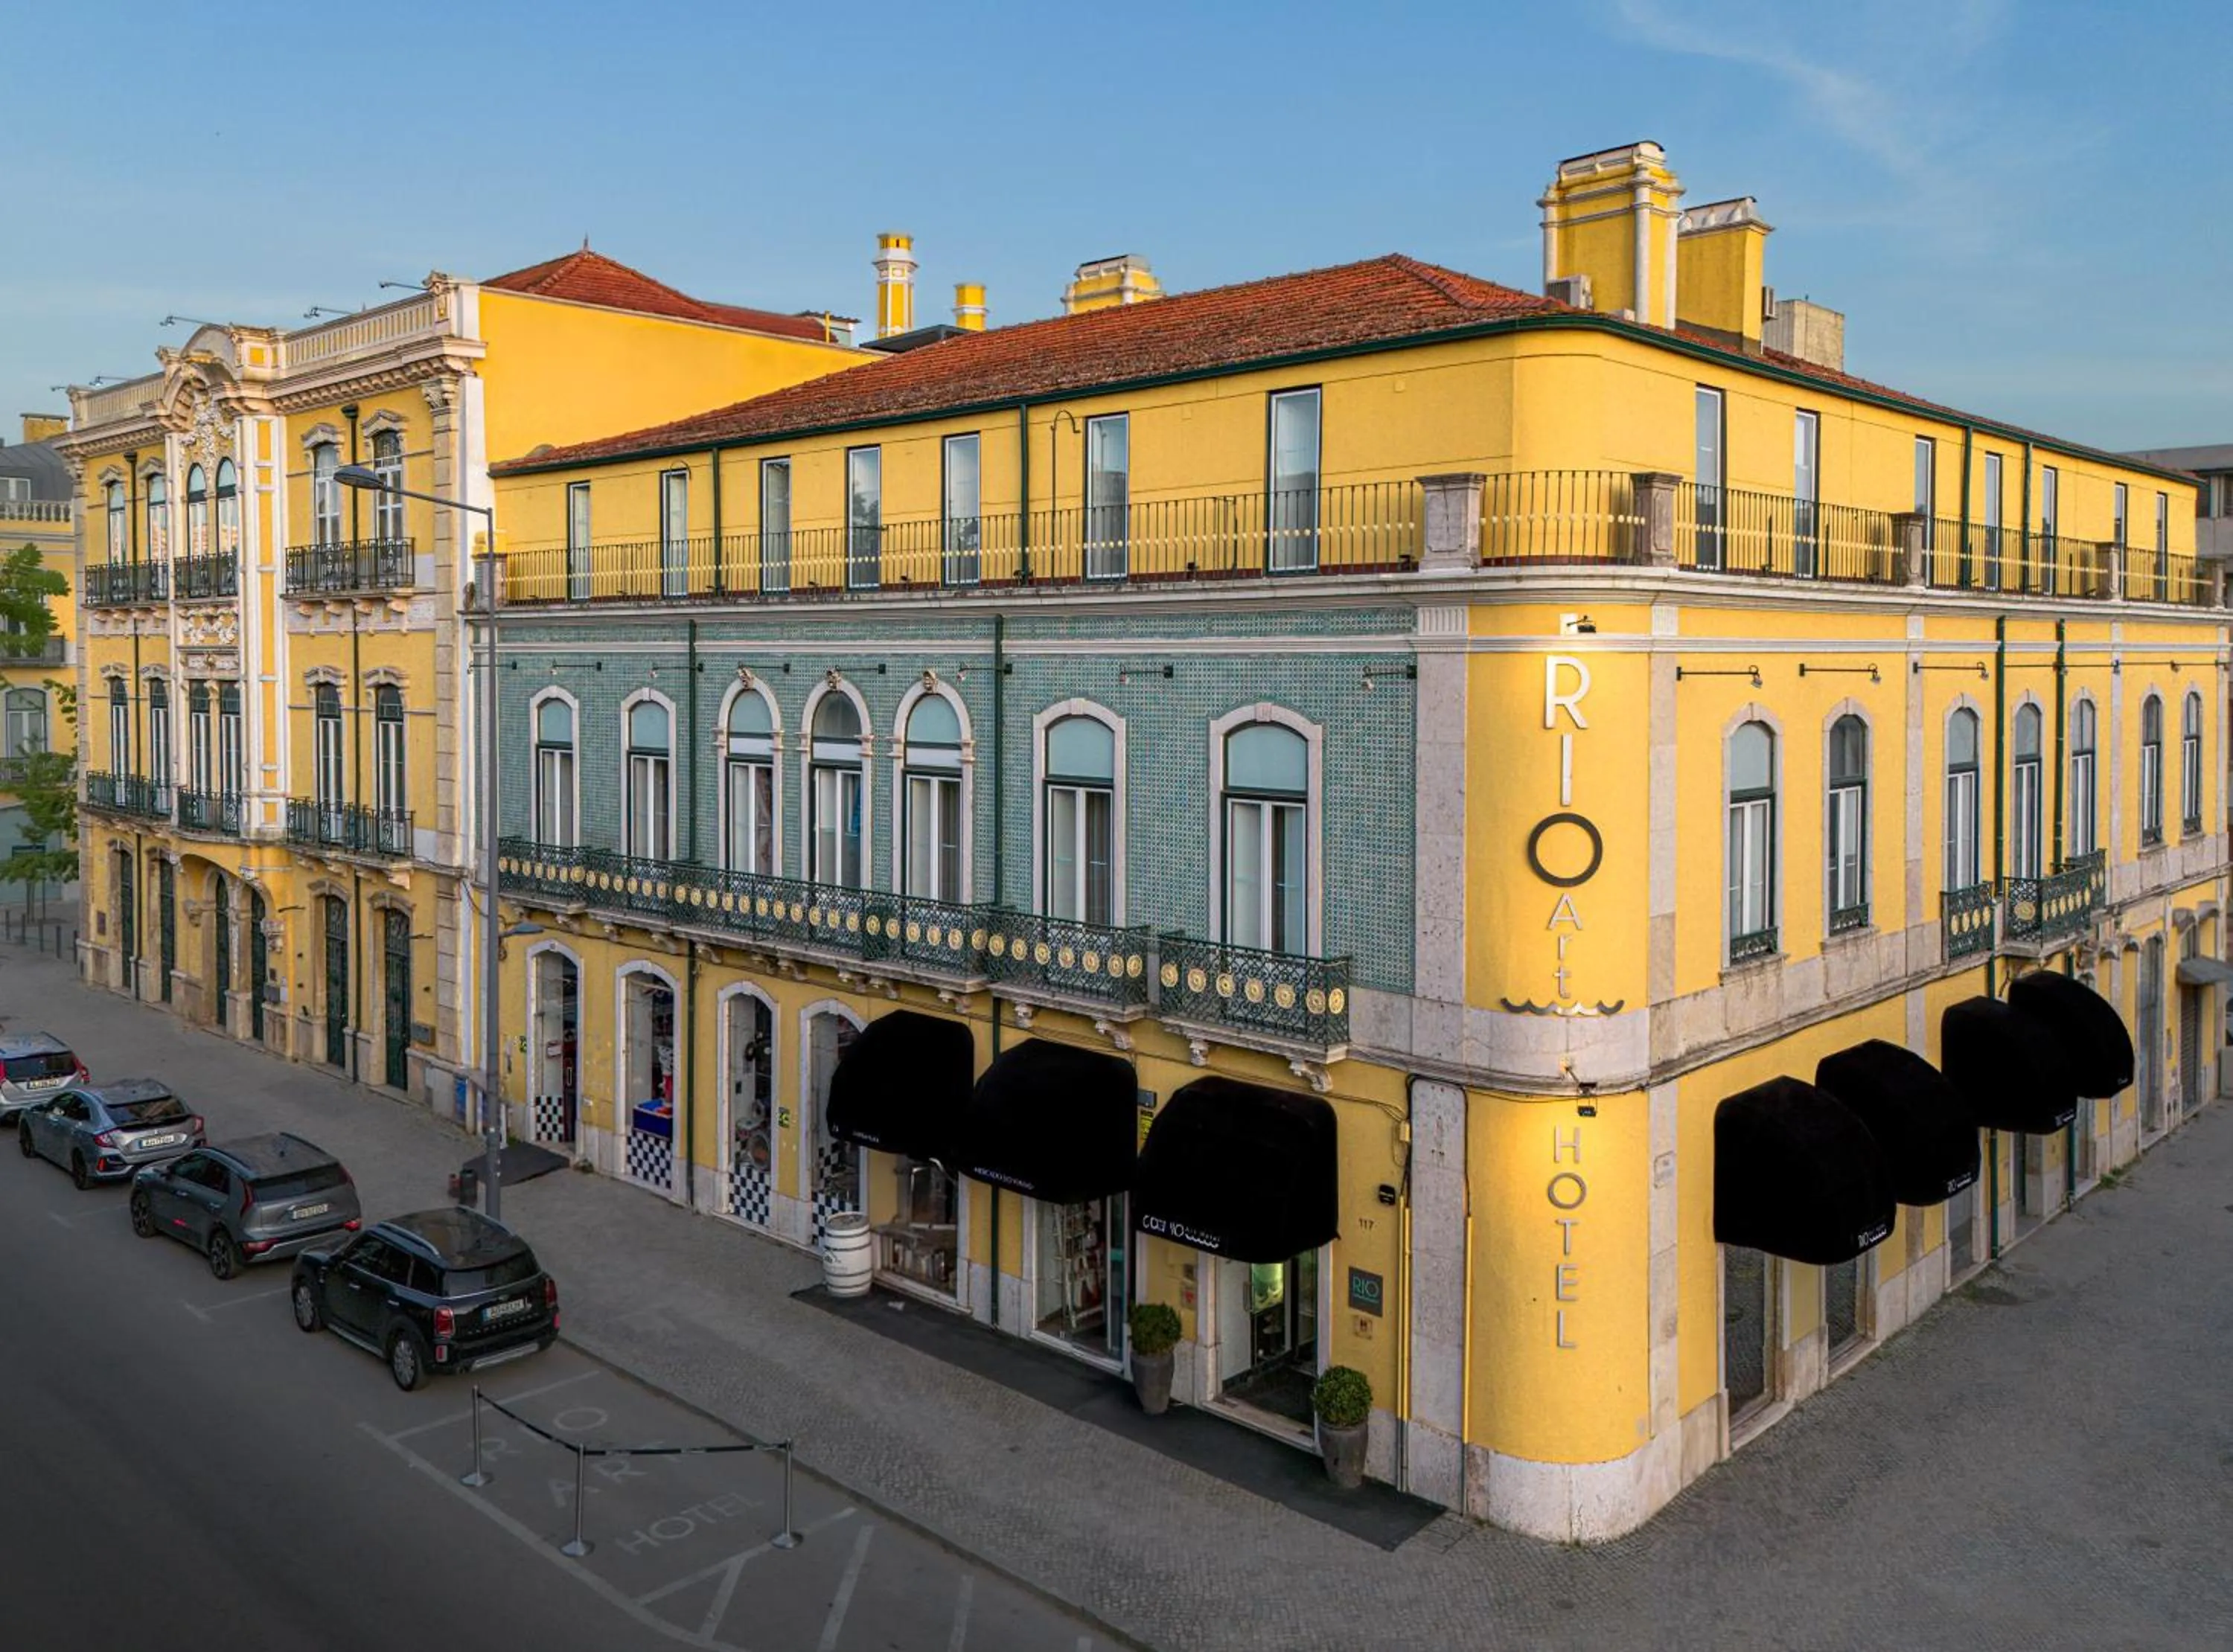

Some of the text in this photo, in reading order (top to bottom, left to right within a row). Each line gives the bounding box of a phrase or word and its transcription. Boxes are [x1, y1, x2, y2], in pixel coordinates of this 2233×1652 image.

[1528, 655, 1603, 999] RIO Art
[1358, 1218, 1376, 1230] 117
[1547, 1124, 1587, 1348] HOTEL
[1352, 1275, 1380, 1298] RIO
[615, 1492, 765, 1556] HOTEL
